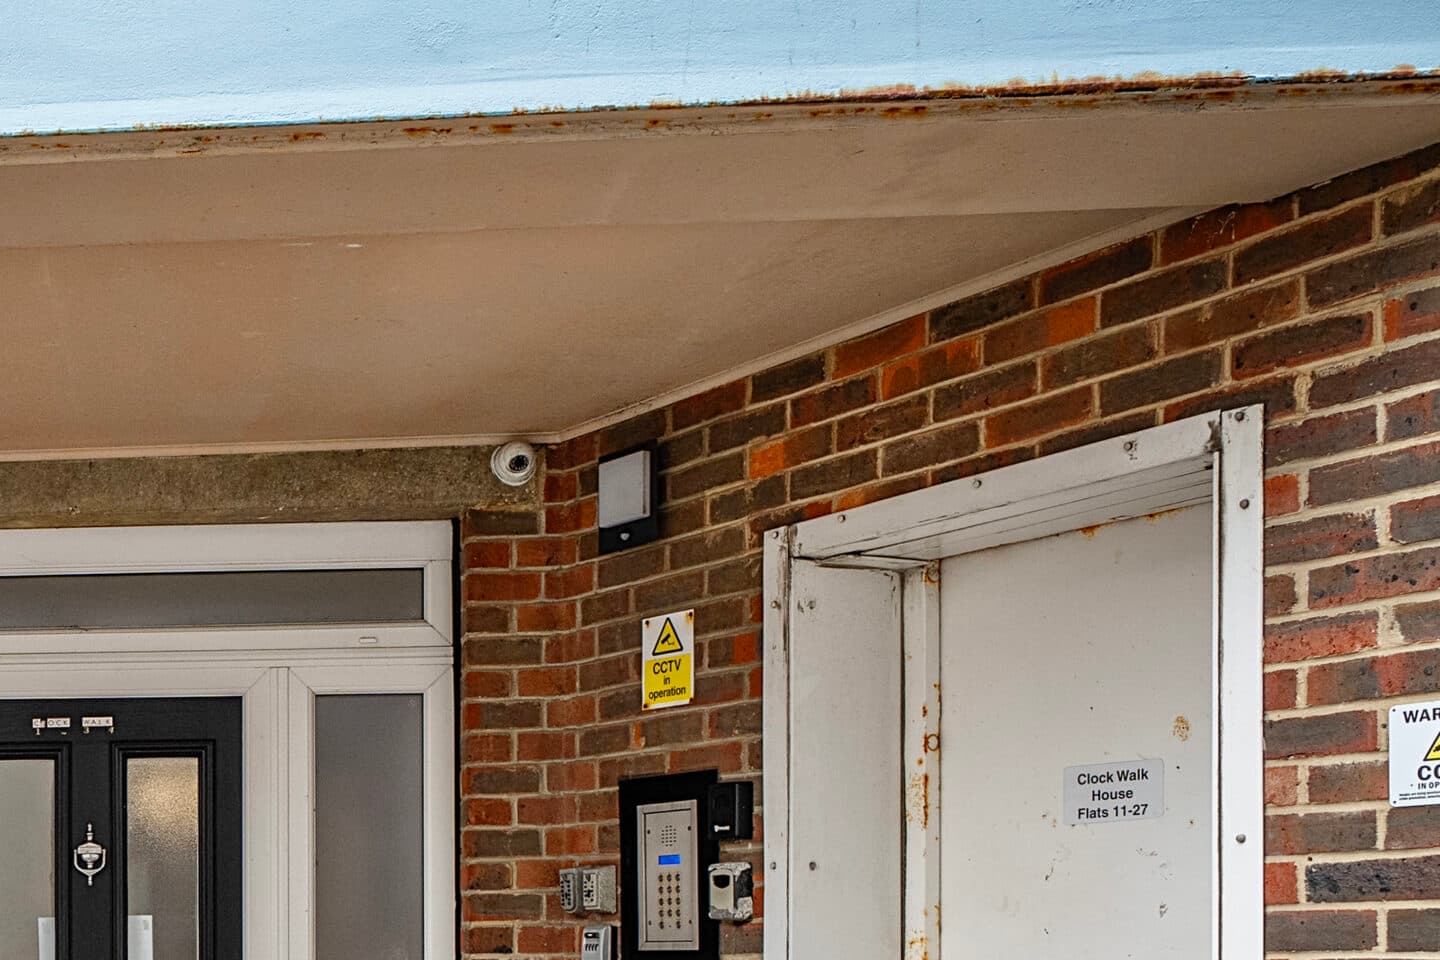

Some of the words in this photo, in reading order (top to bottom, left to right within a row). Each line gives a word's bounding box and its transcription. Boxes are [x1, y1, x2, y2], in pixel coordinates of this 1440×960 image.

[653, 658, 682, 675] CCTV
[663, 674, 671, 685] in
[648, 685, 687, 701] operation
[33, 719, 69, 727] COCK
[1077, 771, 1114, 786] Clock
[1116, 768, 1149, 782] Walk
[1418, 782, 1427, 790] IN
[1091, 789, 1134, 801] House
[1077, 807, 1109, 820] Flats
[1113, 803, 1149, 817] 11-27
